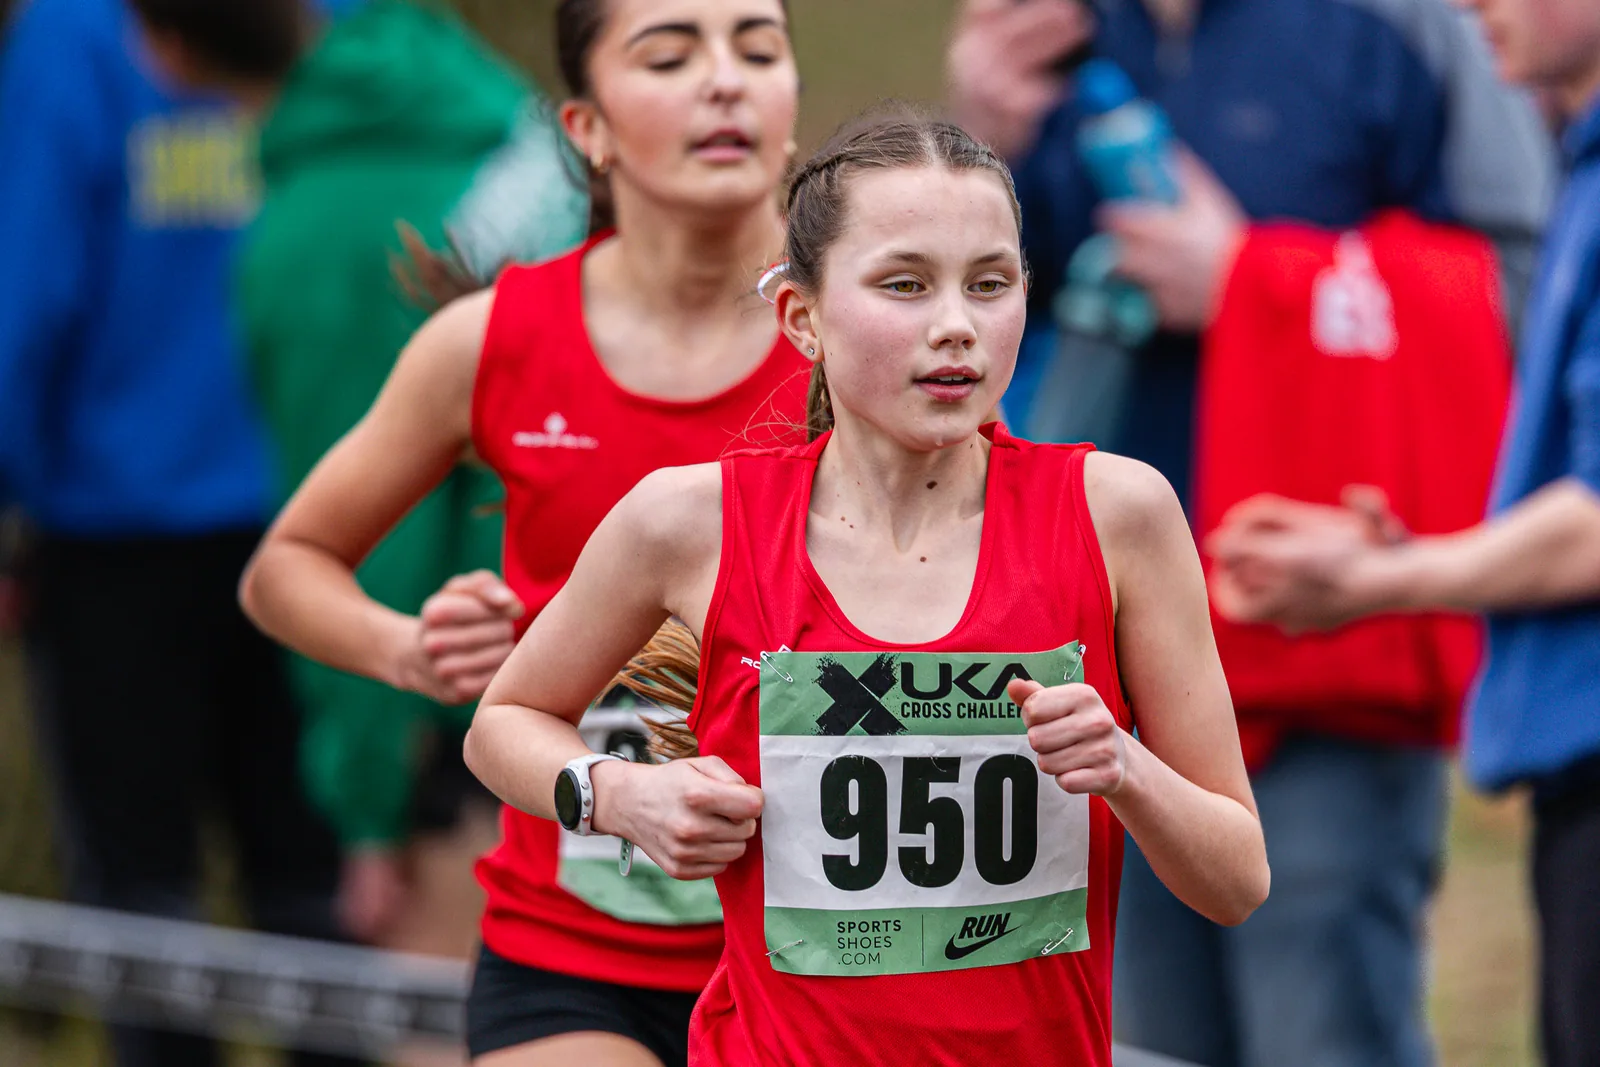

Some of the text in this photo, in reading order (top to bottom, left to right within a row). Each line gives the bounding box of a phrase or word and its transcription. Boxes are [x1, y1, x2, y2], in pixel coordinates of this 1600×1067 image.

[901, 662, 1033, 700] UKA
[901, 702, 951, 718] CROSS
[820, 753, 1038, 891] 950
[837, 919, 901, 933] SPORTS
[958, 912, 1011, 939] RUN
[837, 936, 892, 949] SHOES
[838, 952, 881, 965] .COM
